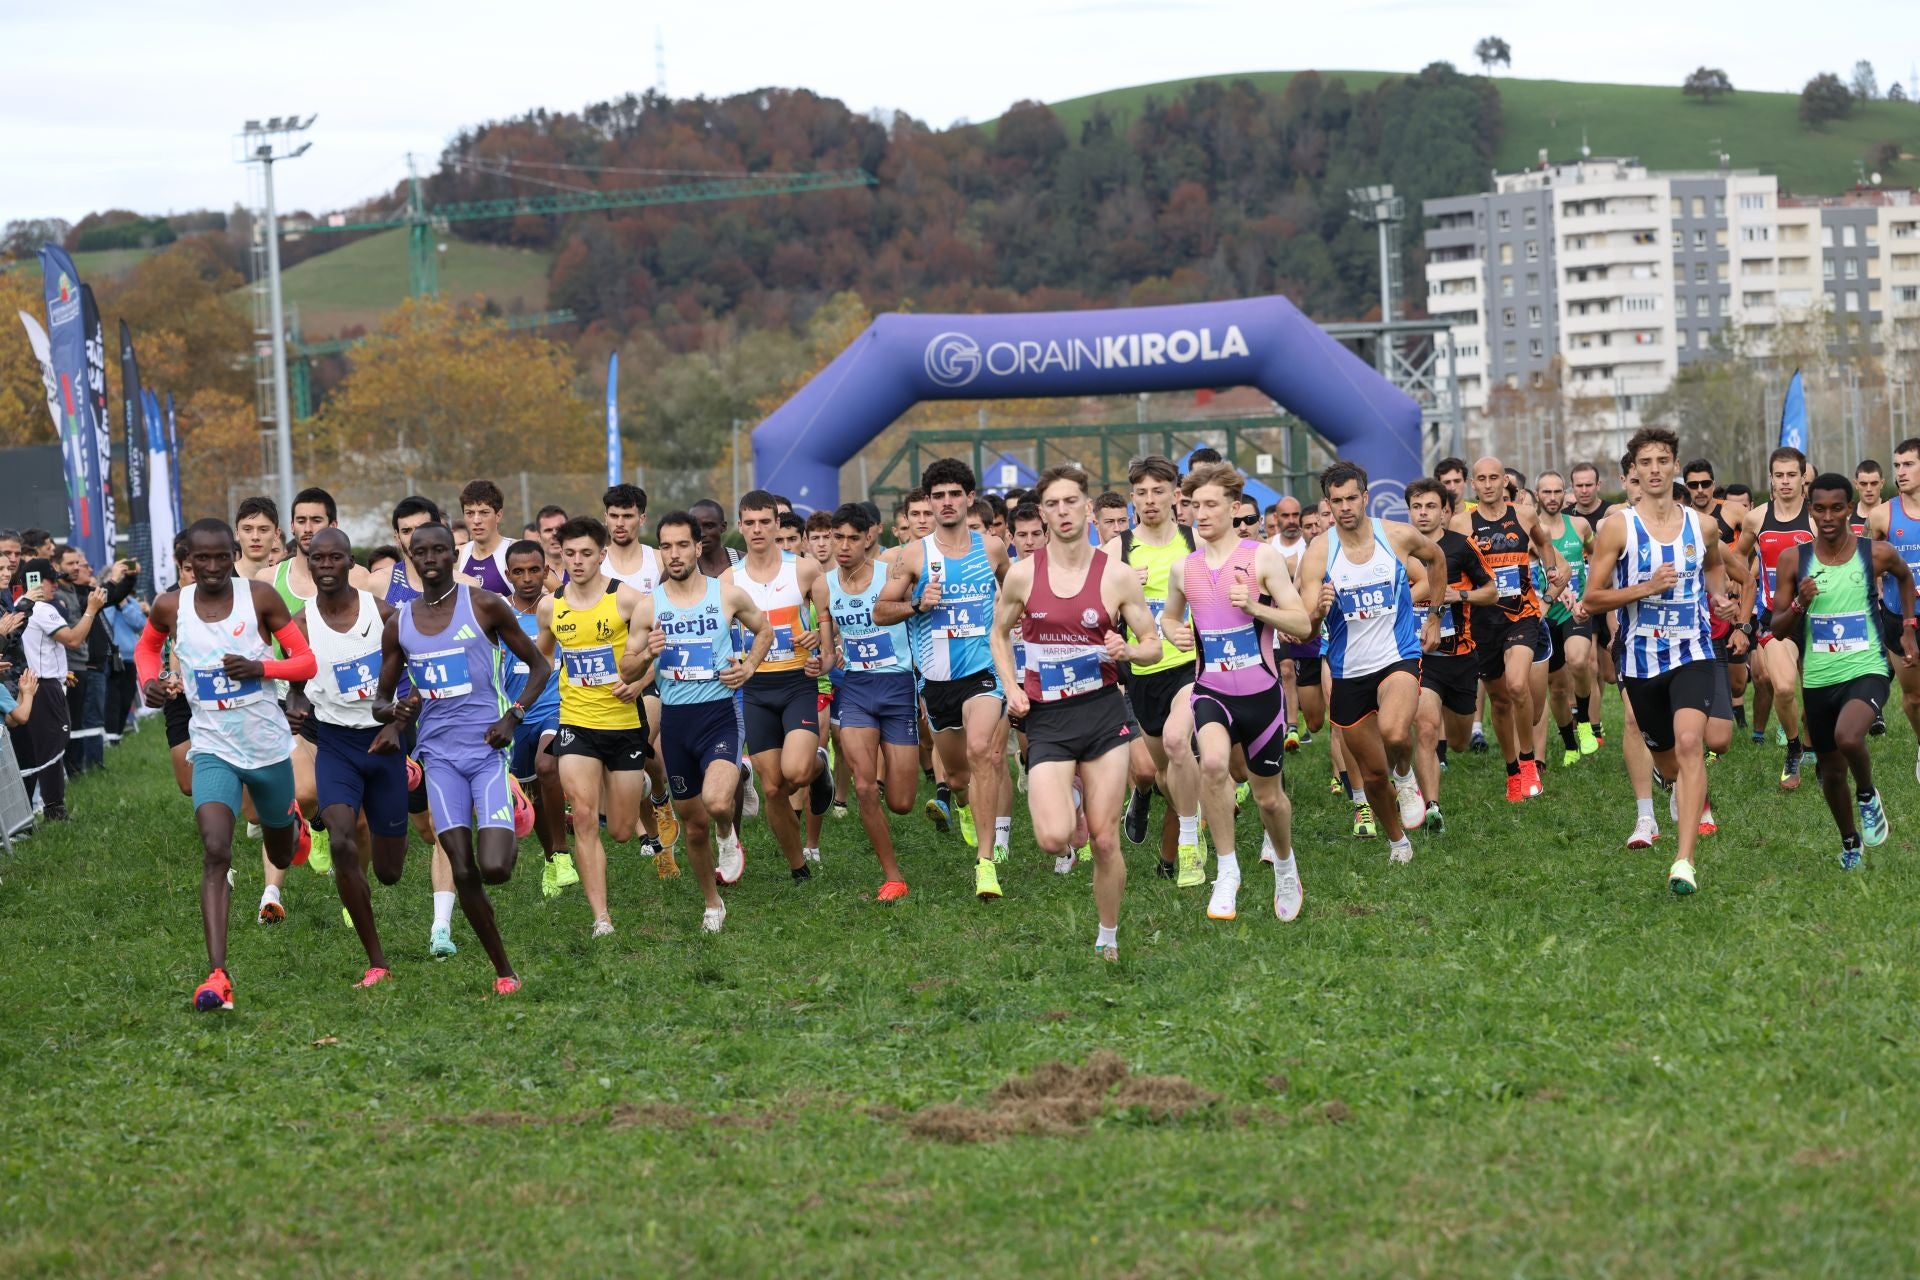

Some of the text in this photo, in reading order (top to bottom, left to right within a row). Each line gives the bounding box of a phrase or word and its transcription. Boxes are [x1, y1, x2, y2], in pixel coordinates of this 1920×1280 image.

[942, 583, 978, 595] LOSA
[1352, 590, 1385, 608] 108
[661, 614, 718, 636] nerja
[836, 608, 872, 627] nerj
[947, 609, 970, 625] 14
[1658, 610, 1680, 626] 13
[557, 624, 576, 632] INDO
[1832, 624, 1845, 640] 9
[1039, 633, 1090, 642] MULLINGAR
[859, 643, 879, 658] 23
[1223, 640, 1237, 656] 4
[573, 657, 606, 674] 173
[678, 650, 690, 666] 7
[357, 664, 373, 683] 2
[424, 664, 448, 684] 41
[1062, 666, 1076, 684] 5
